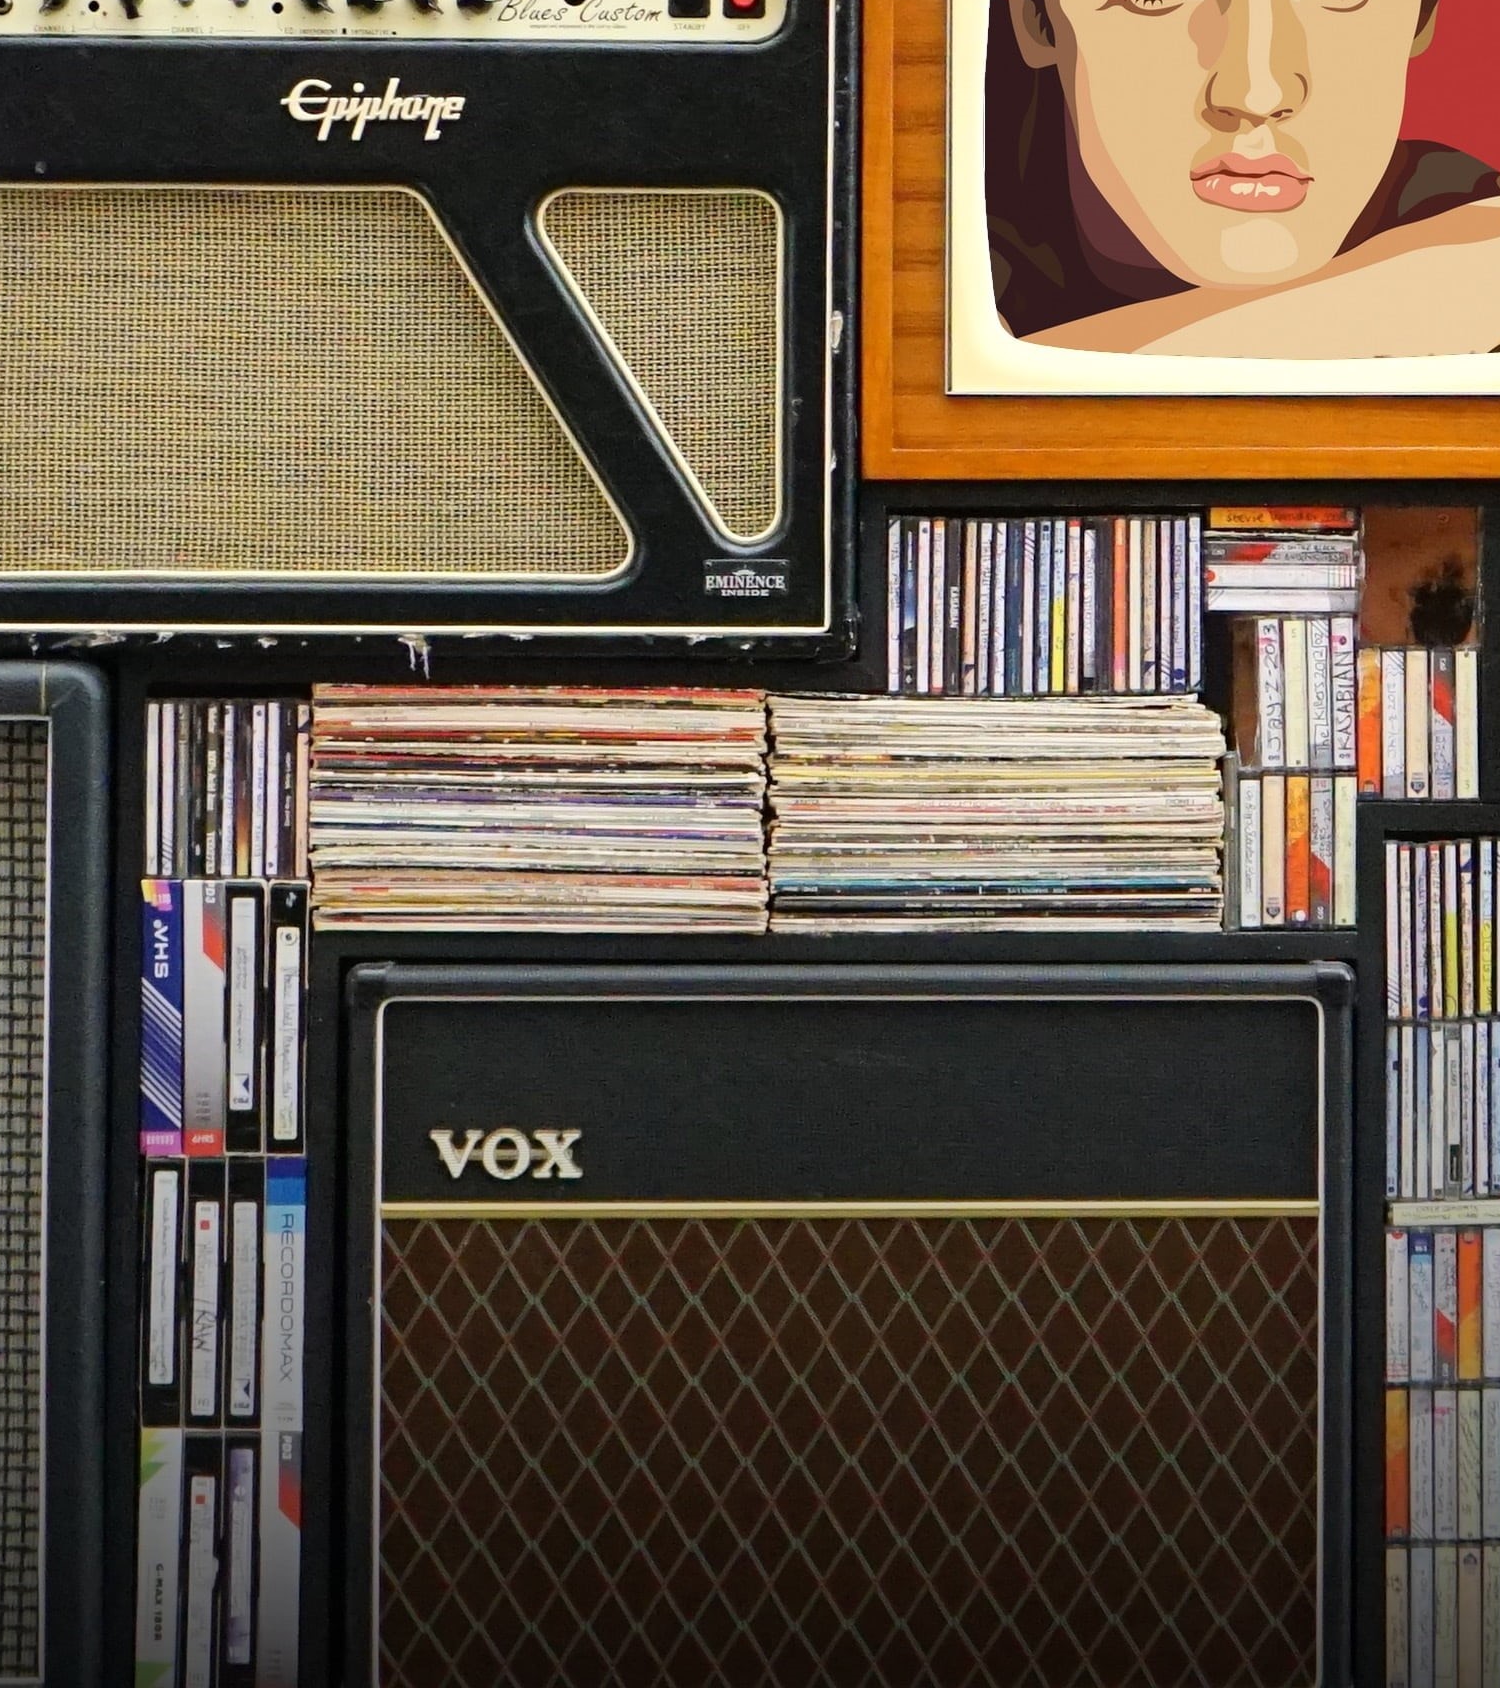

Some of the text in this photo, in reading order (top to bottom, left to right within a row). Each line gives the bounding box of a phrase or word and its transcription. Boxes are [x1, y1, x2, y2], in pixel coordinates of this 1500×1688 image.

[279, 77, 466, 142] Epiphone
[705, 574, 787, 591] EMINENCE
[720, 590, 771, 598] INSIDE
[1336, 649, 1353, 751] KASABIAN
[429, 1127, 583, 1181] VOX
[279, 1213, 294, 1382] RECORDOMAX
